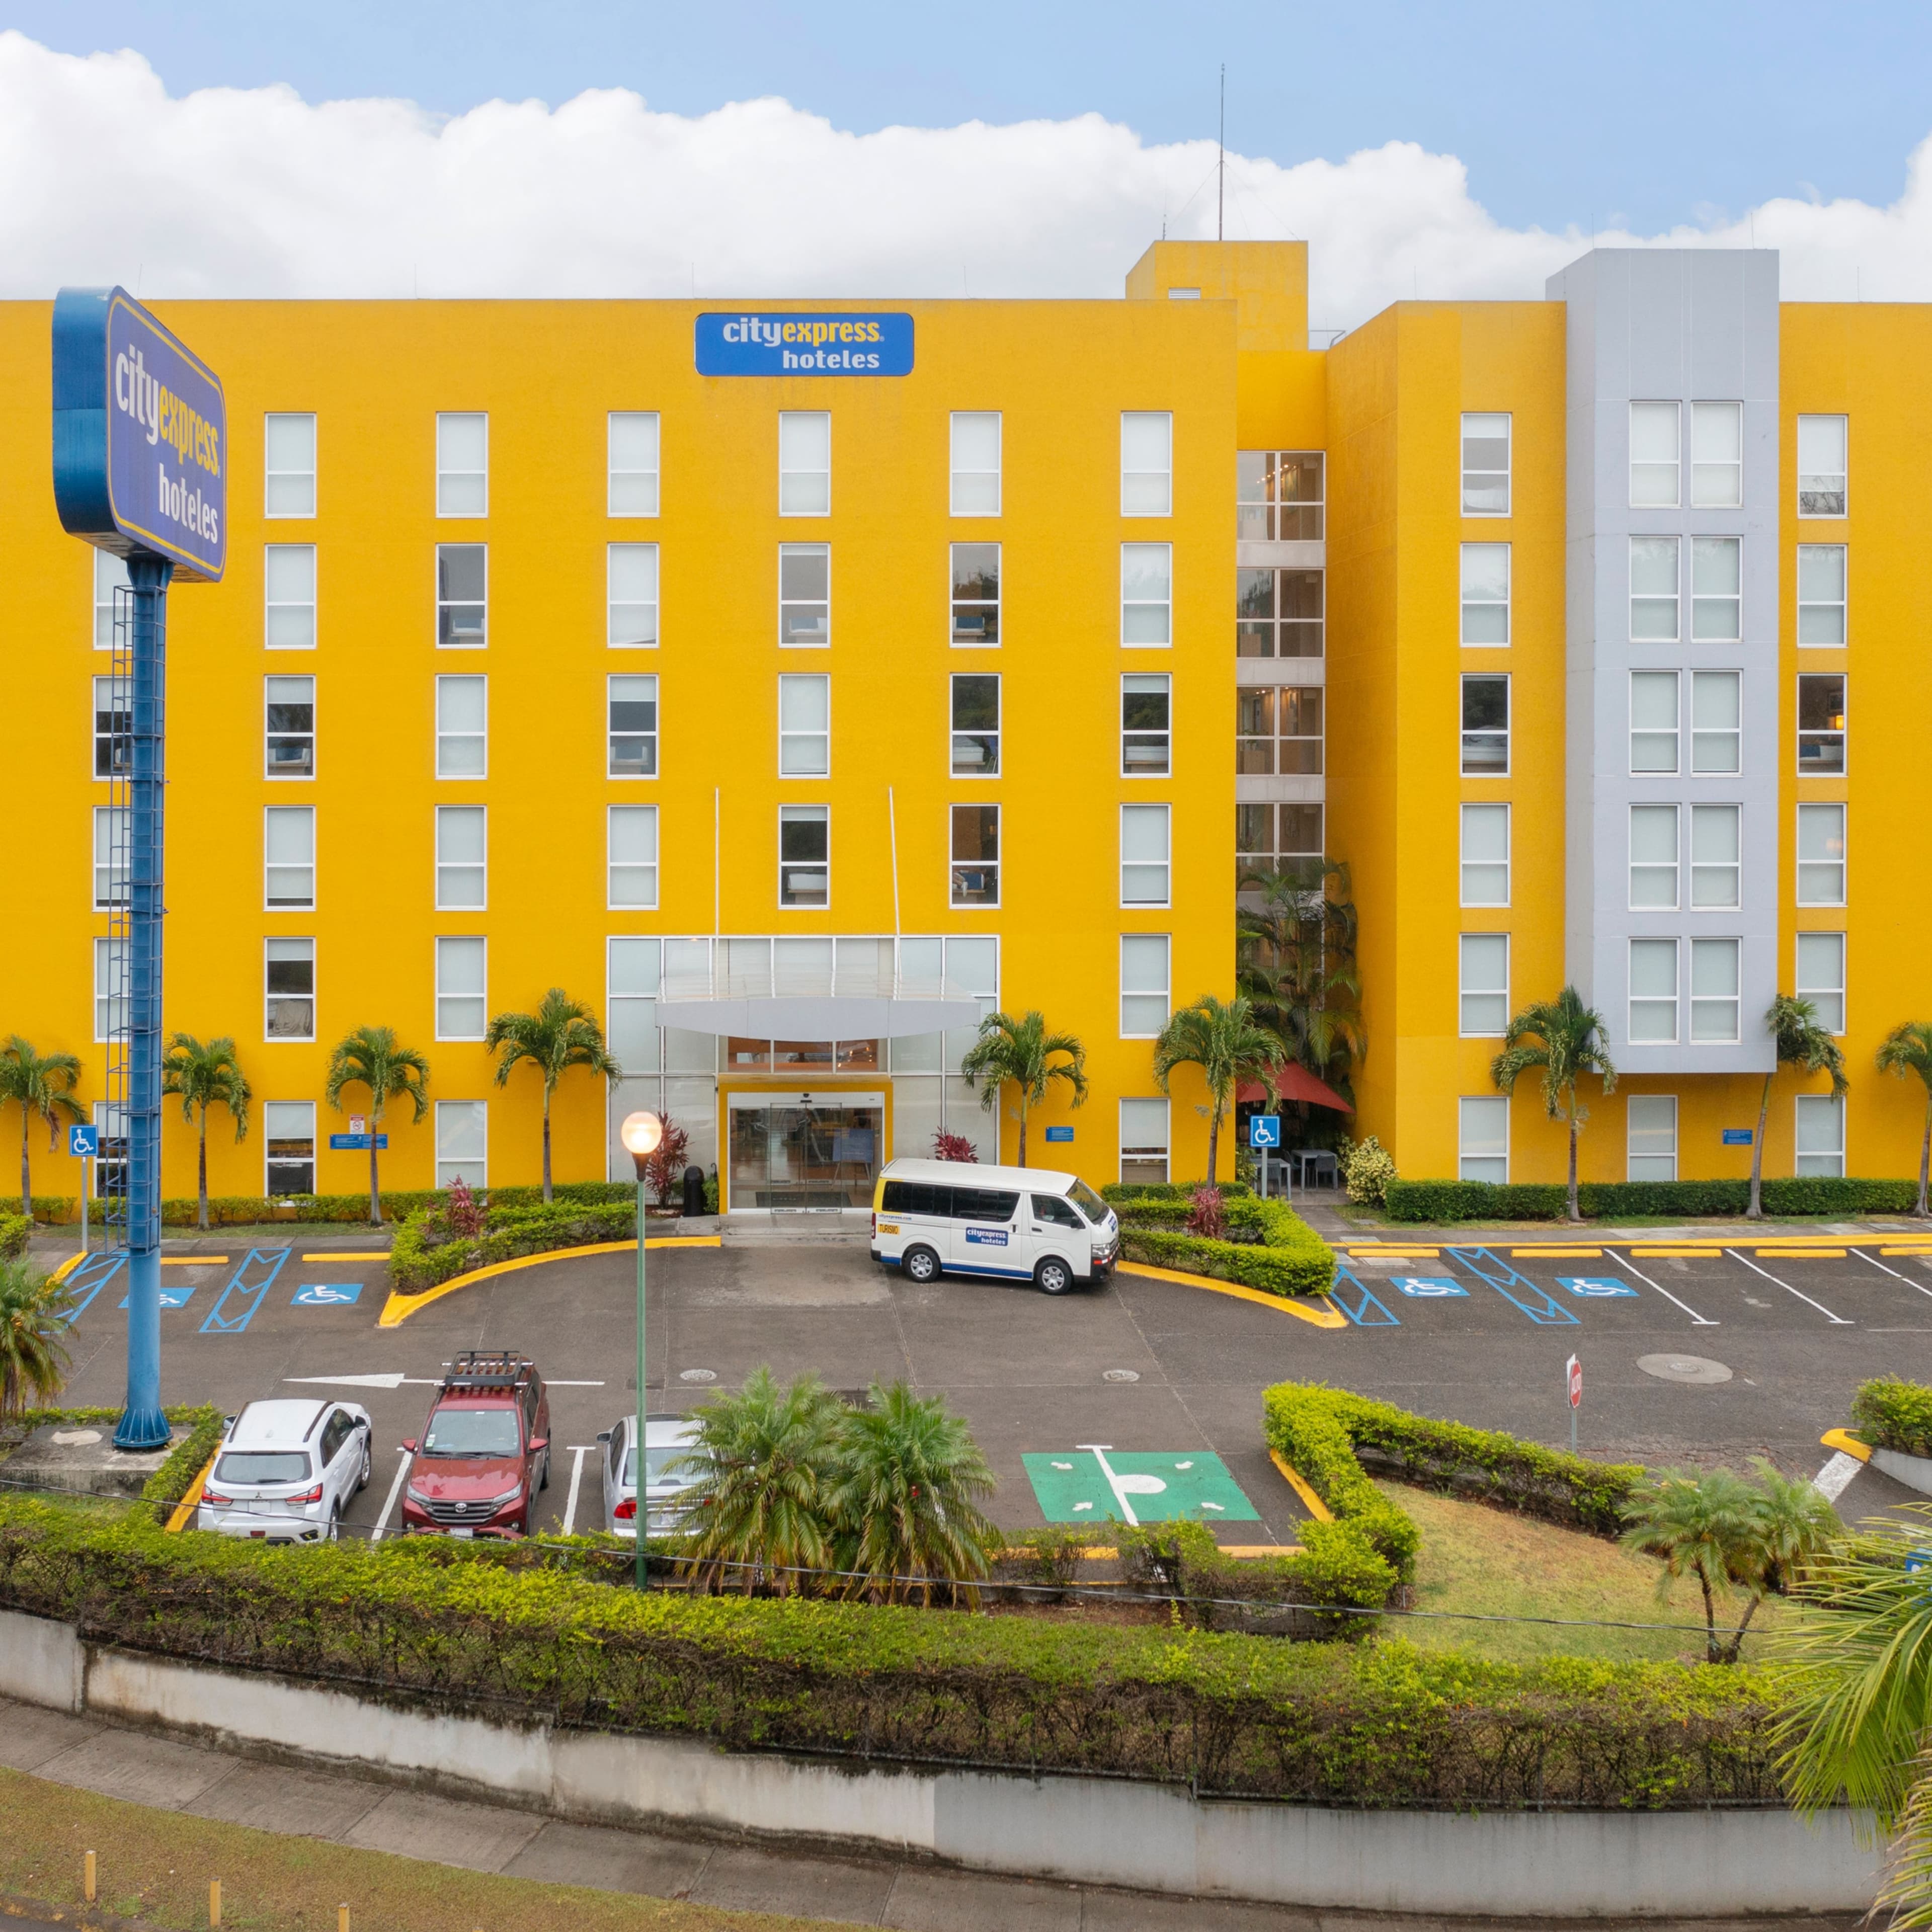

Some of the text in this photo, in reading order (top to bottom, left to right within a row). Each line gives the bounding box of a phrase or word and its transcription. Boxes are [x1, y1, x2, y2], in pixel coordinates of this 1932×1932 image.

[722, 317, 879, 347] cityexpress
[783, 350, 880, 369] hoteles
[115, 343, 218, 477] cityexpress
[159, 462, 217, 544] hoteles
[879, 1224, 899, 1235] TURISMO
[967, 1229, 1006, 1238] cityexpress
[981, 1237, 1006, 1245] hoteles
